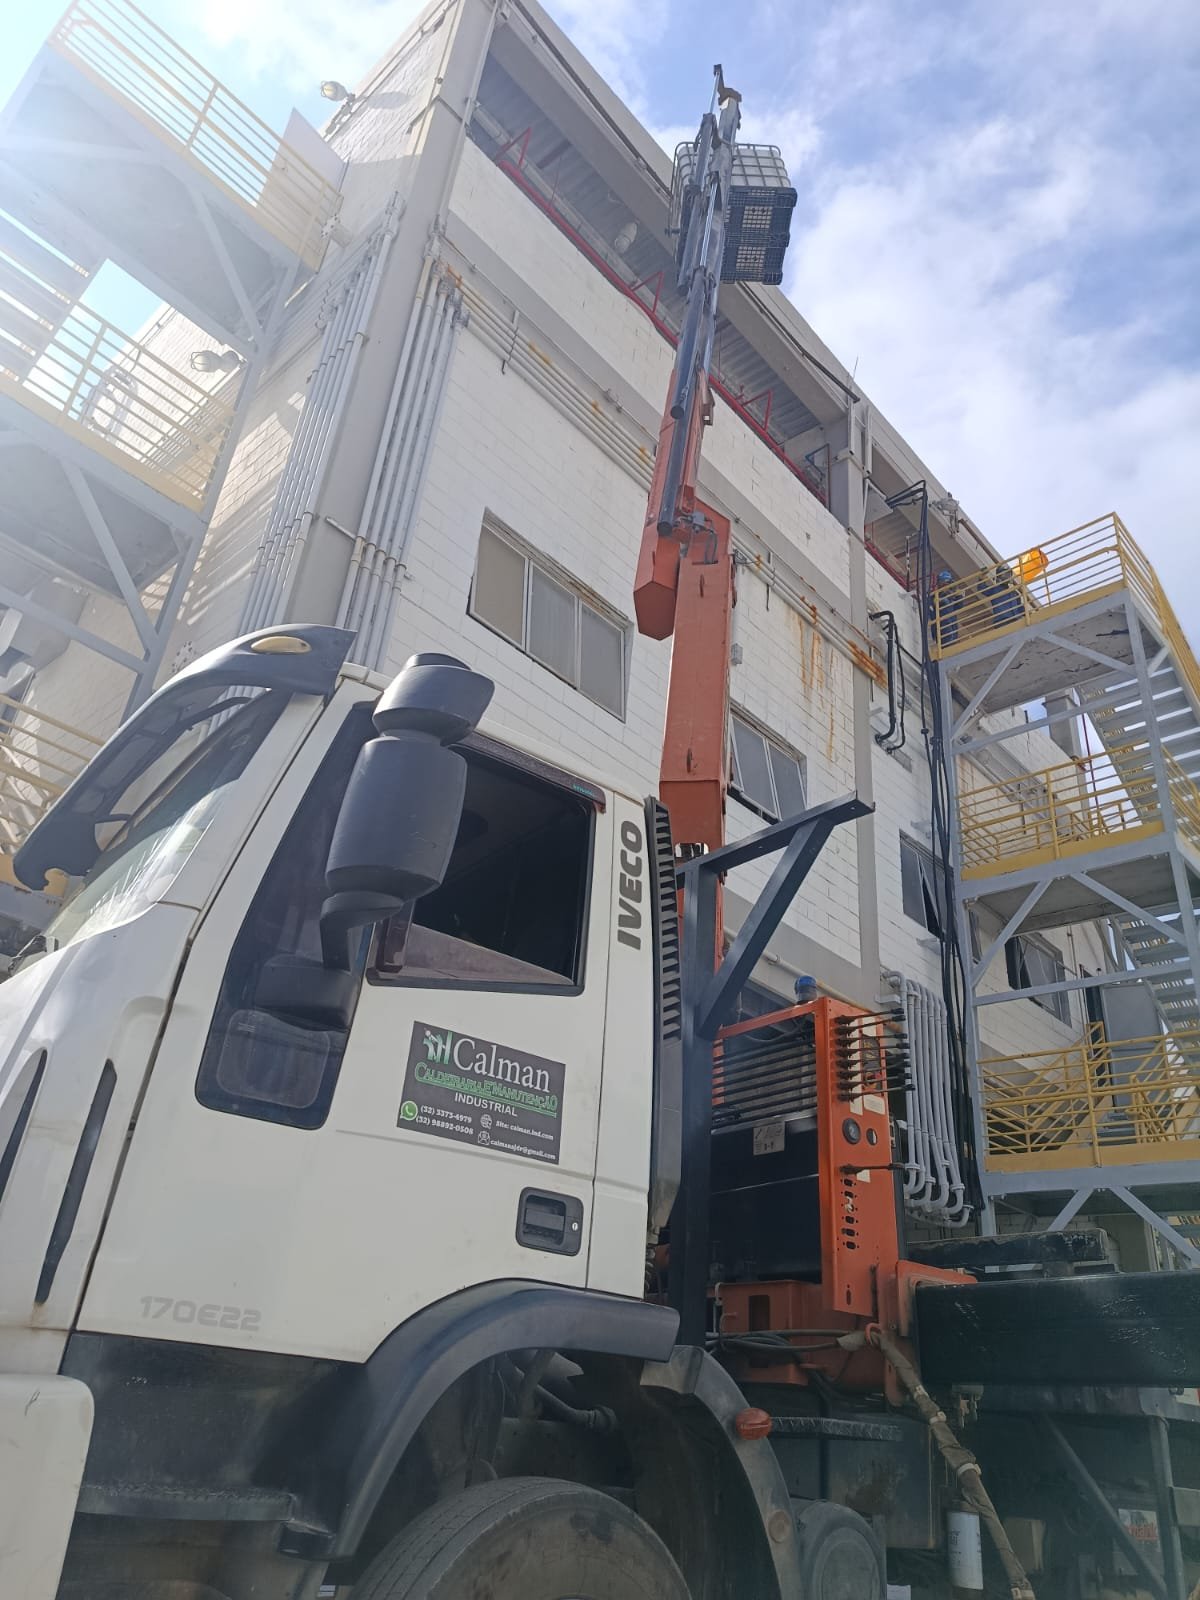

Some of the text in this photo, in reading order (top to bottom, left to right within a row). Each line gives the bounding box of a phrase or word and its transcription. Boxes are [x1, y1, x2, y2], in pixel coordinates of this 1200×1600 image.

[617, 820, 642, 950] IVECO
[453, 1038, 551, 1093] Calman
[420, 1105, 435, 1116] (32)
[454, 1092, 518, 1117] INDUSTRIAL
[415, 1115, 431, 1126] (32)
[495, 1120, 509, 1129] Site:
[140, 1295, 262, 1332] 170E22
